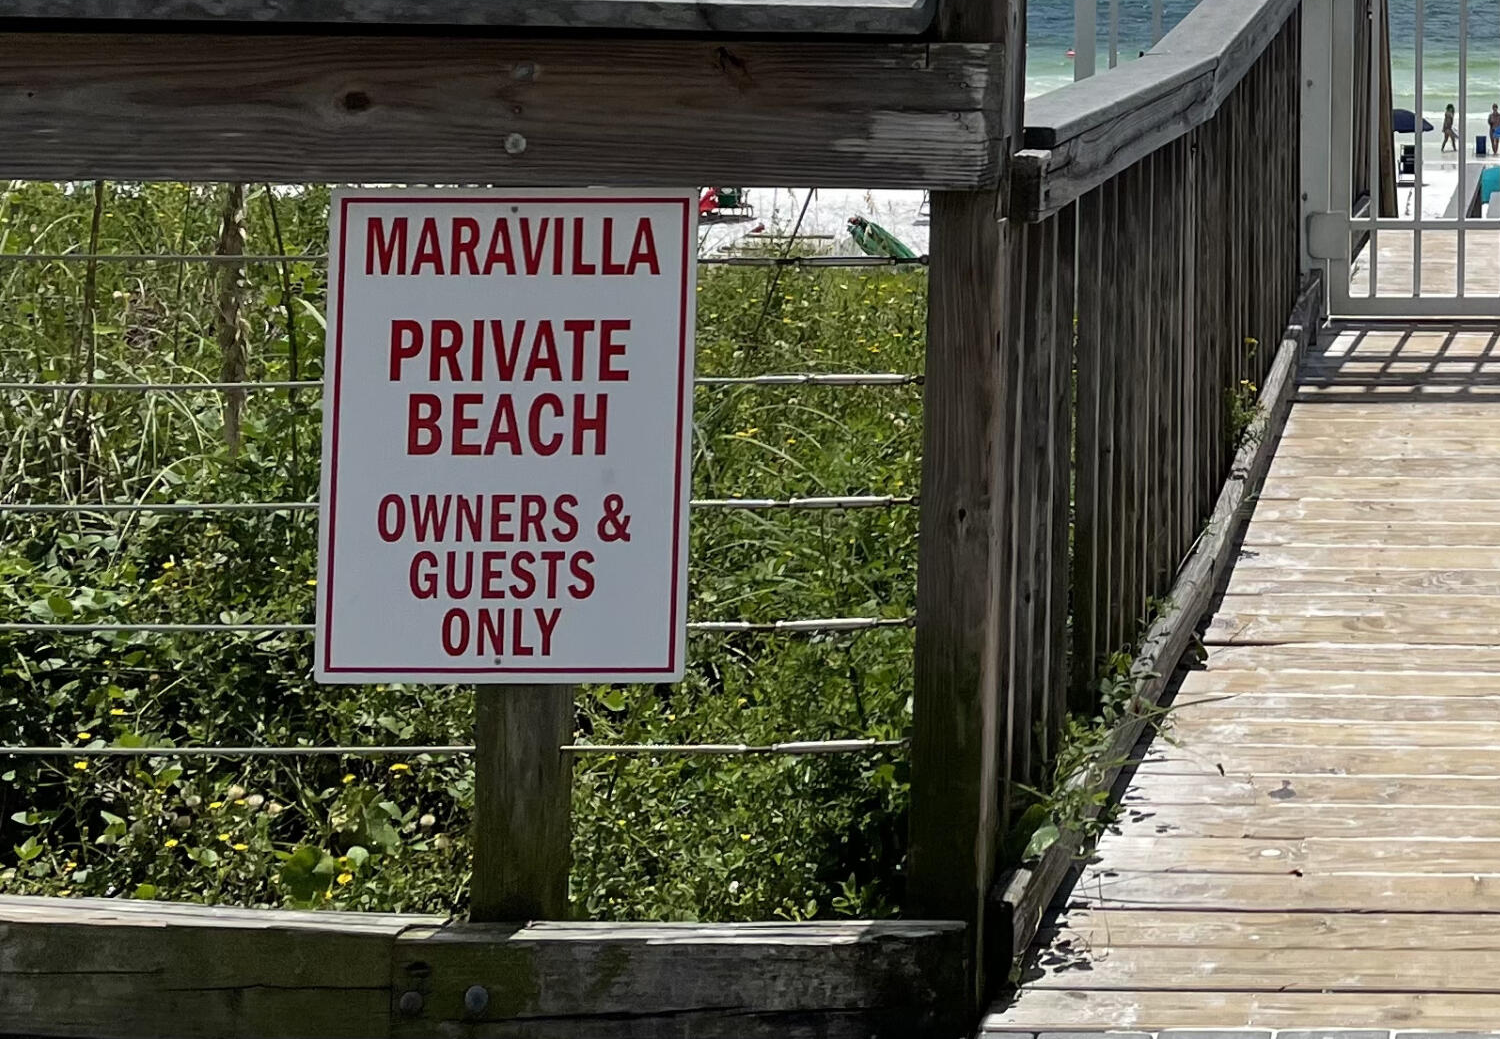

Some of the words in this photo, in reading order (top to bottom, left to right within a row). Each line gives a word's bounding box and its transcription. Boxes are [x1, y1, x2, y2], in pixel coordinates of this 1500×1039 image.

[365, 217, 660, 275] MARAVILLA
[390, 320, 631, 382] PRIVATE
[407, 393, 608, 456] BEACH
[378, 494, 579, 543] OWNERS
[597, 494, 631, 543] &
[410, 551, 595, 599] GUESTS
[442, 608, 562, 656] ONLY
